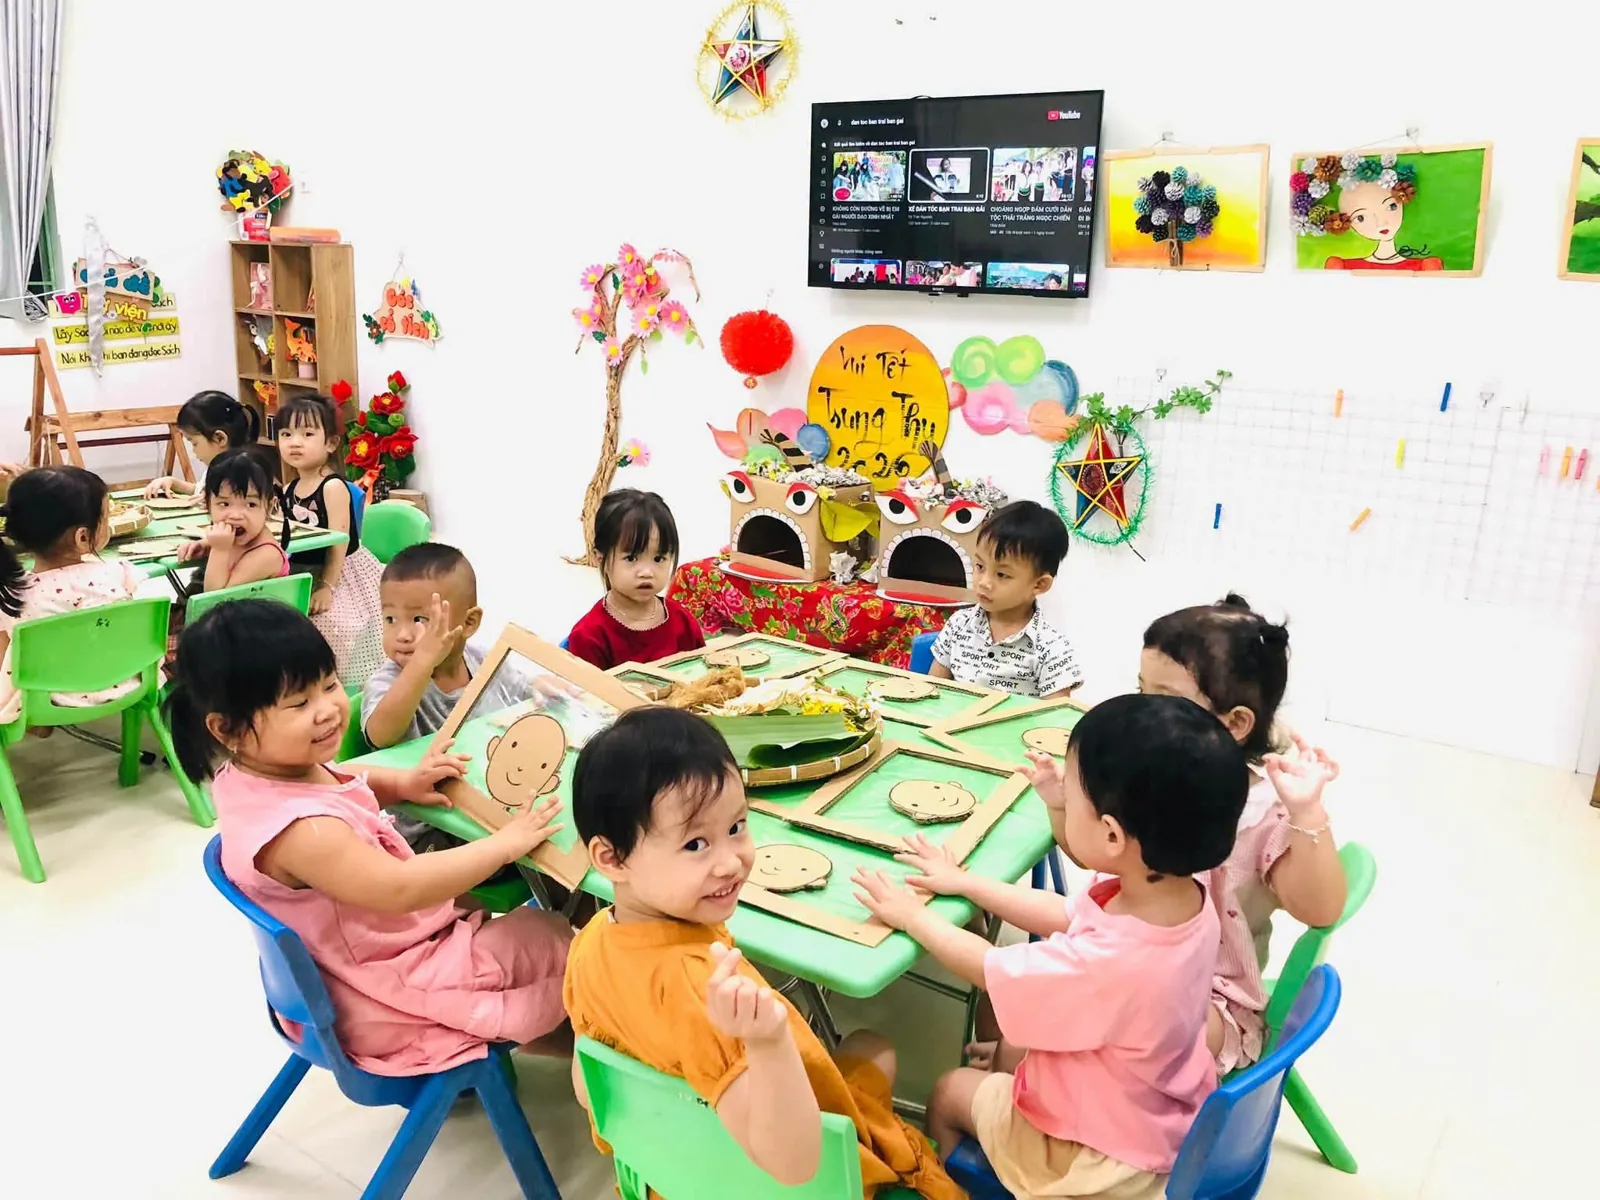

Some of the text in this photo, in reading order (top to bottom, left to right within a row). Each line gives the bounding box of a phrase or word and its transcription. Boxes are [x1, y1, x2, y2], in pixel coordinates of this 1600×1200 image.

[1059, 110, 1081, 120] YouTube
[114, 302, 147, 322] viện
[961, 650, 985, 662] SPORT
[1000, 650, 1026, 662] SPORT
[1047, 655, 1073, 673] SPORT
[989, 679, 1019, 689] SPORT
